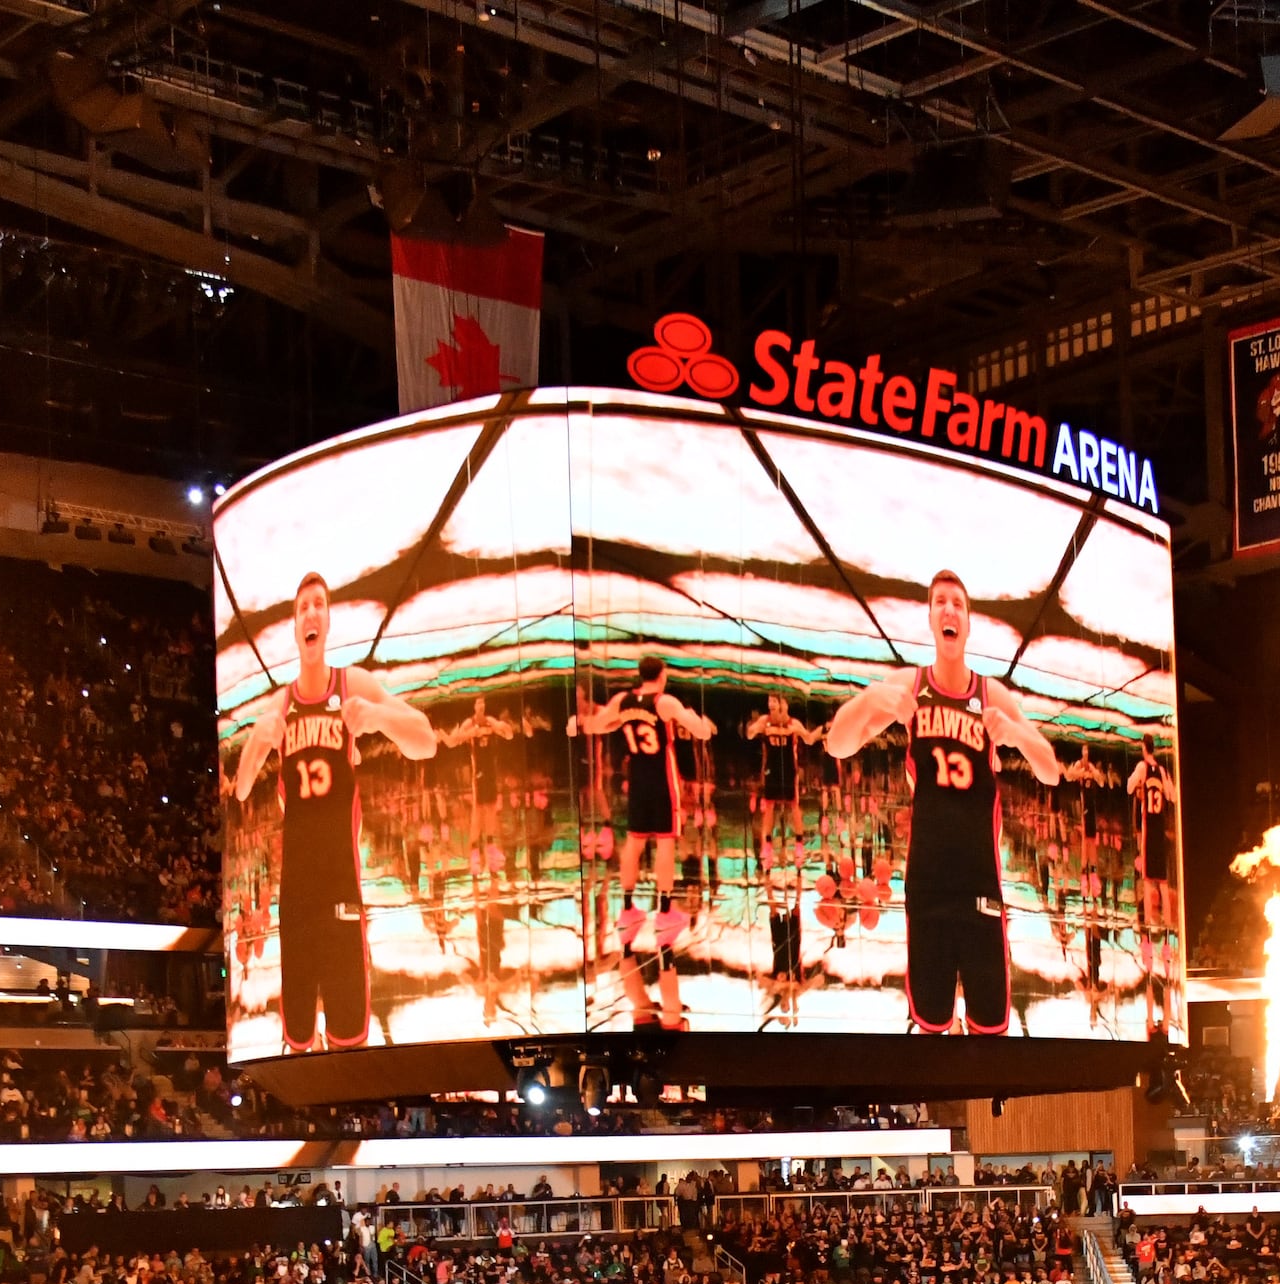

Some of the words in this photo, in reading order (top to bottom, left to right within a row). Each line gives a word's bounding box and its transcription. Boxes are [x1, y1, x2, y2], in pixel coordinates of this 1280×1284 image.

[1051, 422, 1160, 514] ARENA
[285, 714, 344, 758] HAWKS
[623, 723, 661, 755] 13
[916, 705, 985, 752] HAWKS
[296, 758, 332, 799] 13
[931, 746, 974, 791] 13
